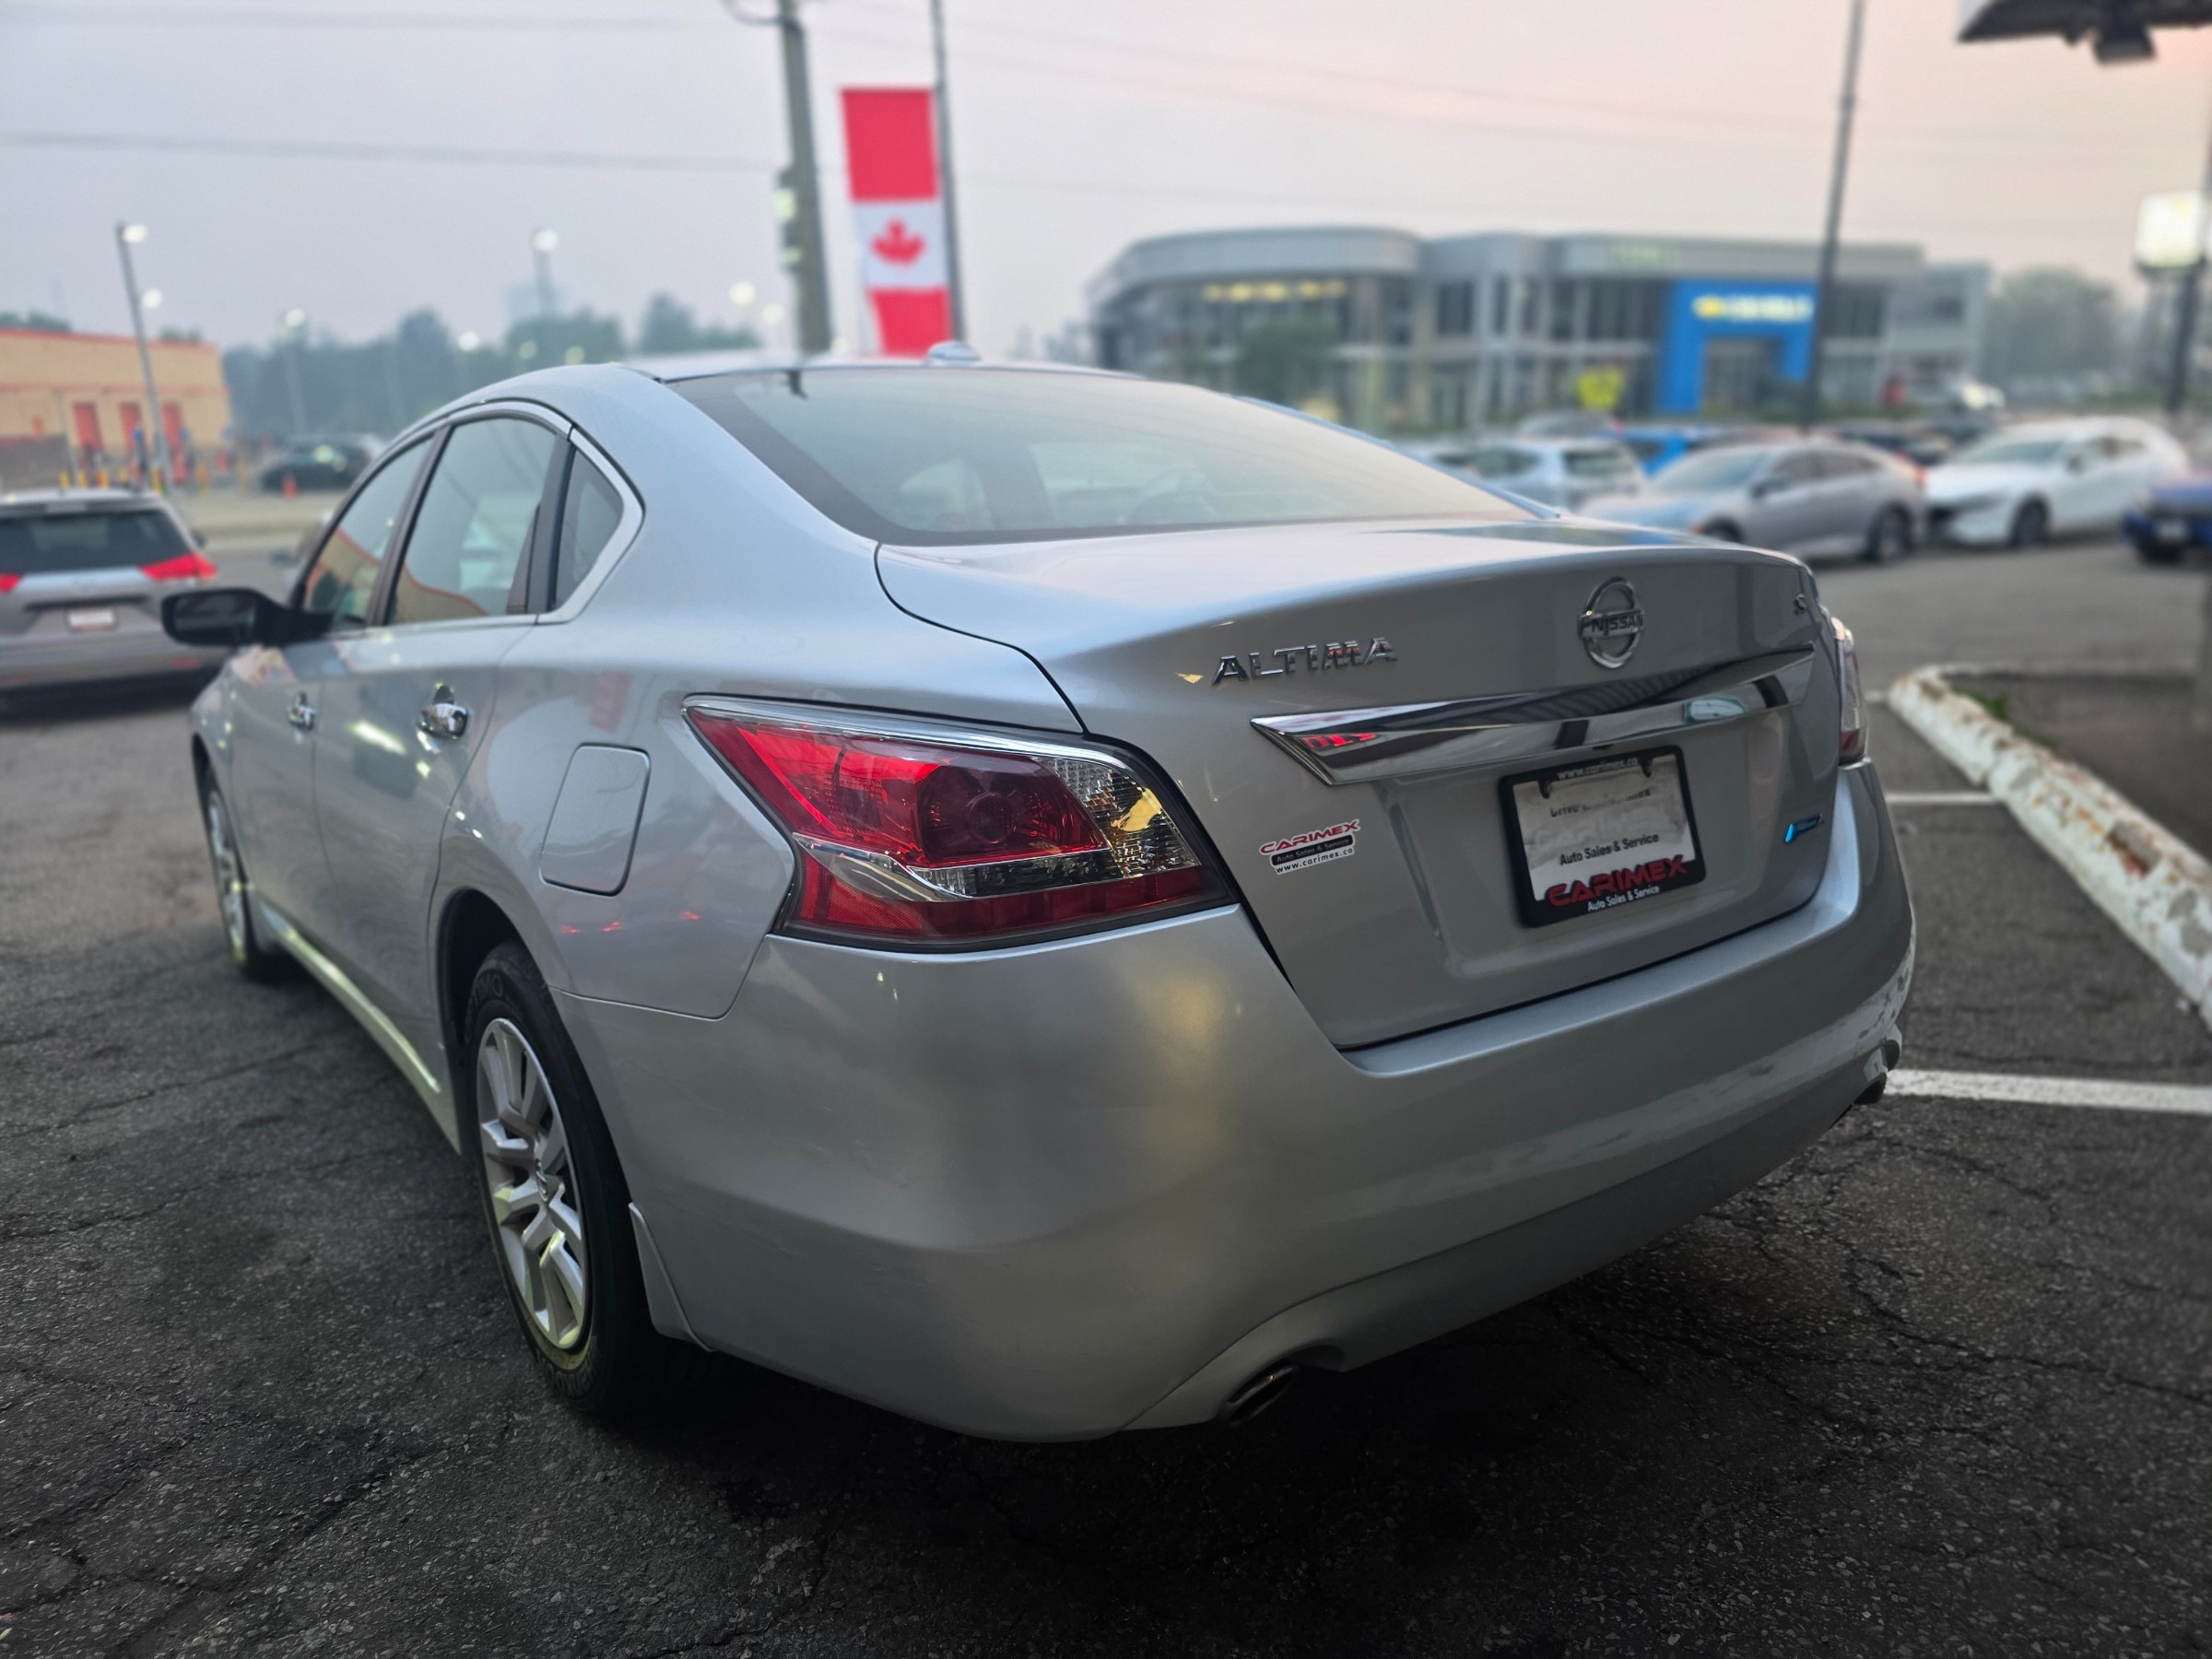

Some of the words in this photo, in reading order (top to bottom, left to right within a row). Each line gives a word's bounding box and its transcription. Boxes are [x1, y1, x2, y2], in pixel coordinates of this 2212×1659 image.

[1591, 614, 1643, 633] NISSAN
[1211, 637, 1399, 686] ALTIMA
[1260, 820, 1359, 853] CARIMEX
[1559, 853, 1583, 866] Auto
[1583, 844, 1612, 860] Sales
[1613, 840, 1621, 853] &
[1622, 833, 1659, 850] Service
[1277, 854, 1295, 864] Auto
[1546, 853, 1688, 907] CARIMEX
[1587, 900, 1606, 912] Auto
[1606, 893, 1626, 907] Sales
[1627, 890, 1634, 901] &
[1634, 885, 1660, 899] Service
